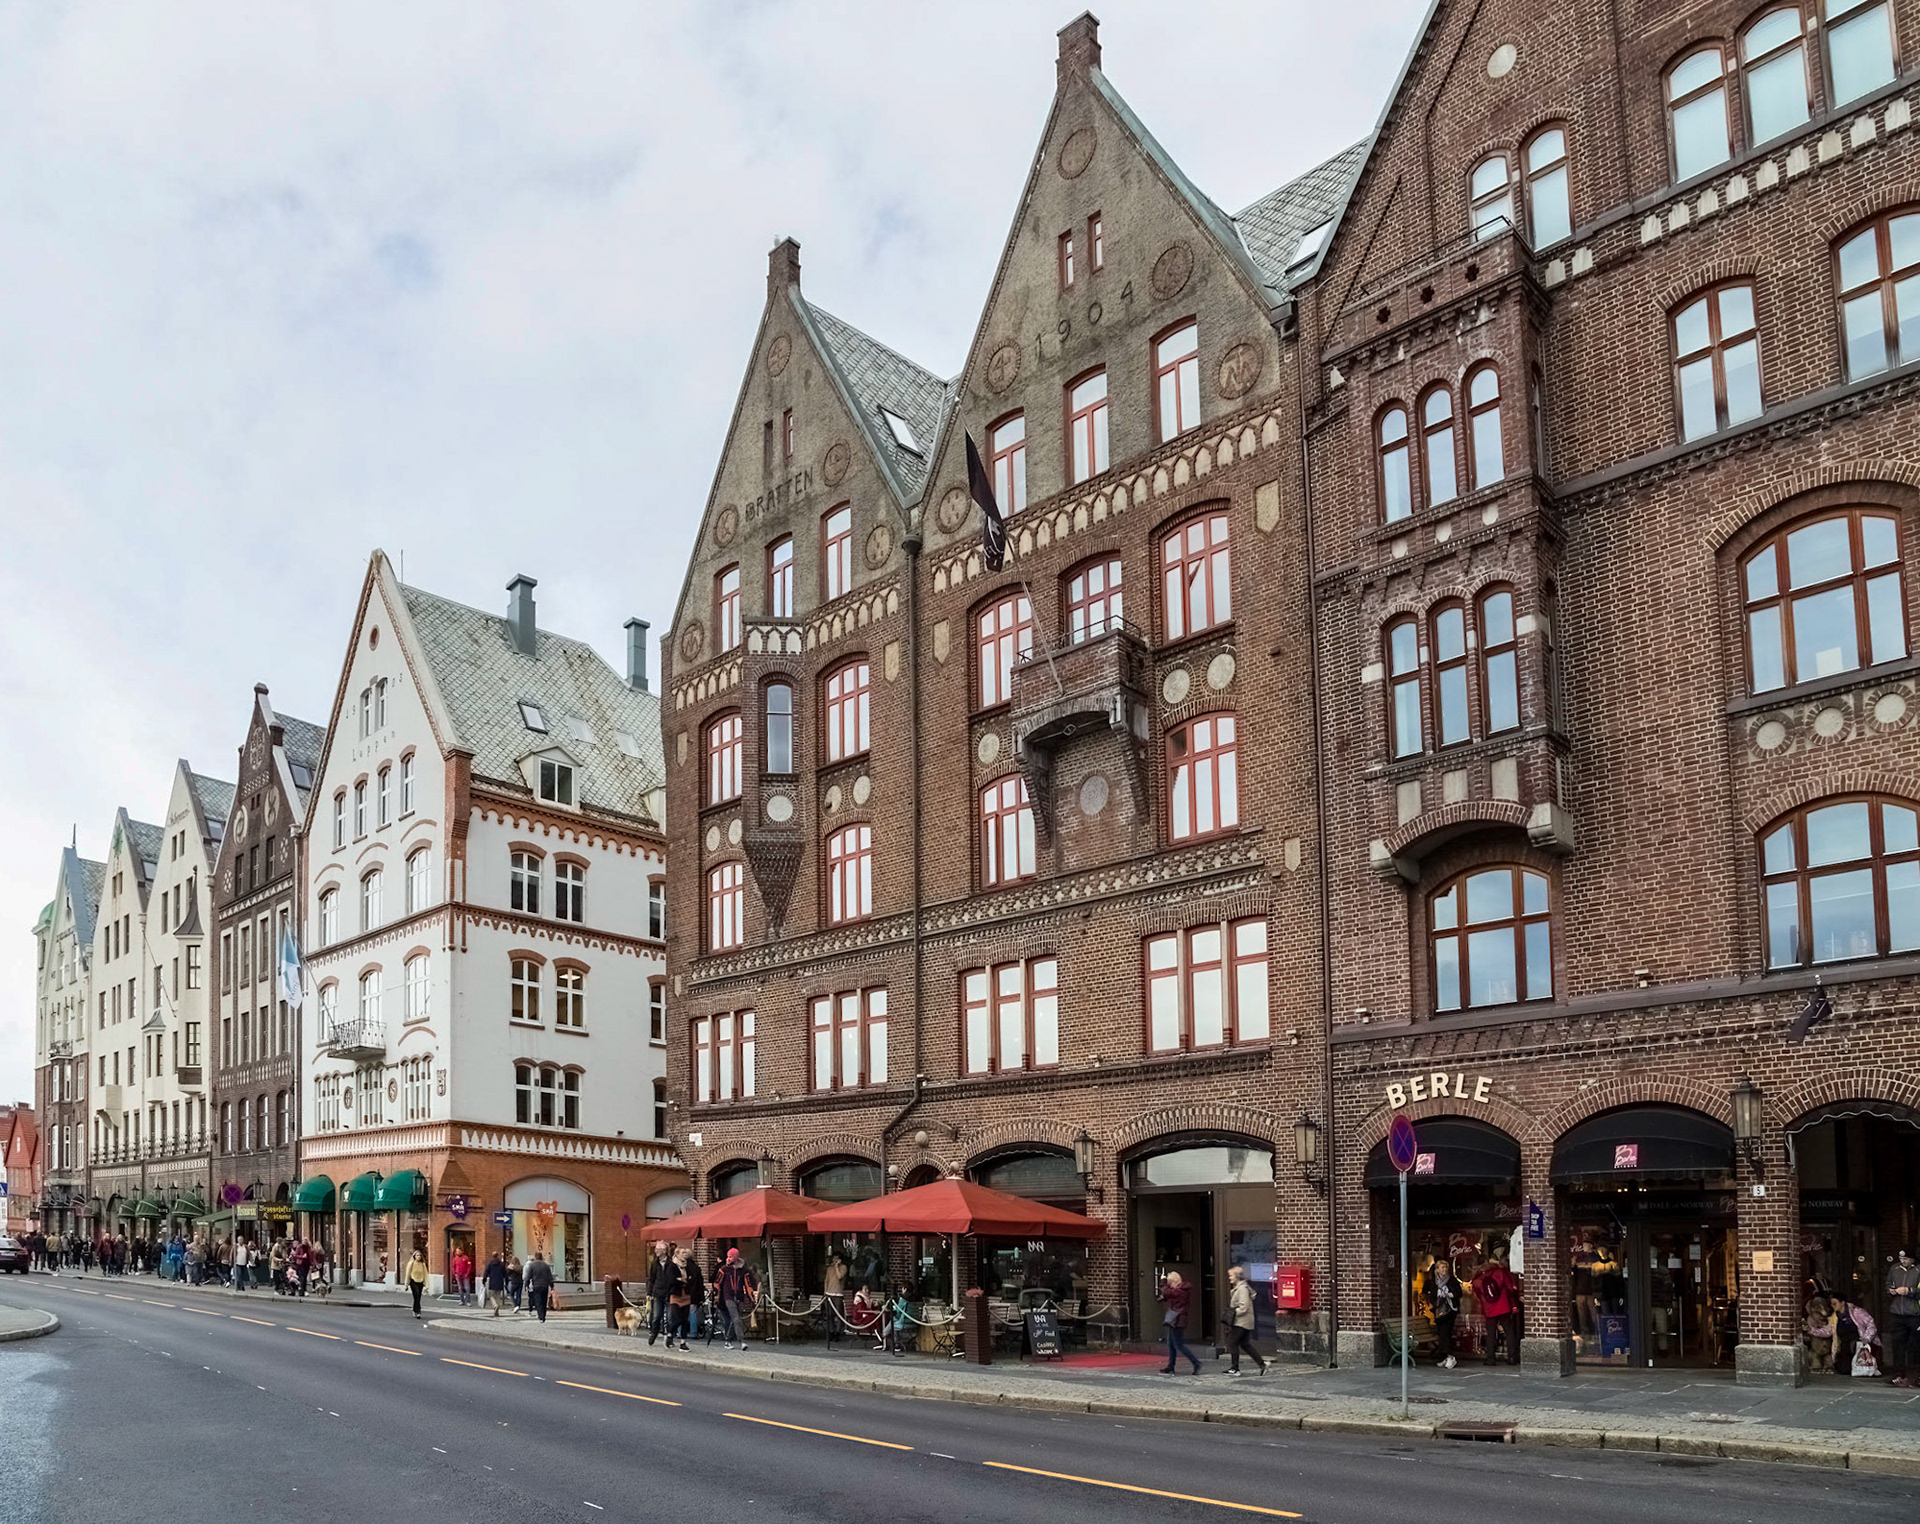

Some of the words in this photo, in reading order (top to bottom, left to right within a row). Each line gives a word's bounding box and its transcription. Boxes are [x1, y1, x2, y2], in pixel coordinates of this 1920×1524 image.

[1034, 281, 1133, 362] 1904
[745, 467, 814, 522] BRATTEN
[1385, 1071, 1493, 1110] BERLE
[1808, 1199, 1844, 1208] NORWAY
